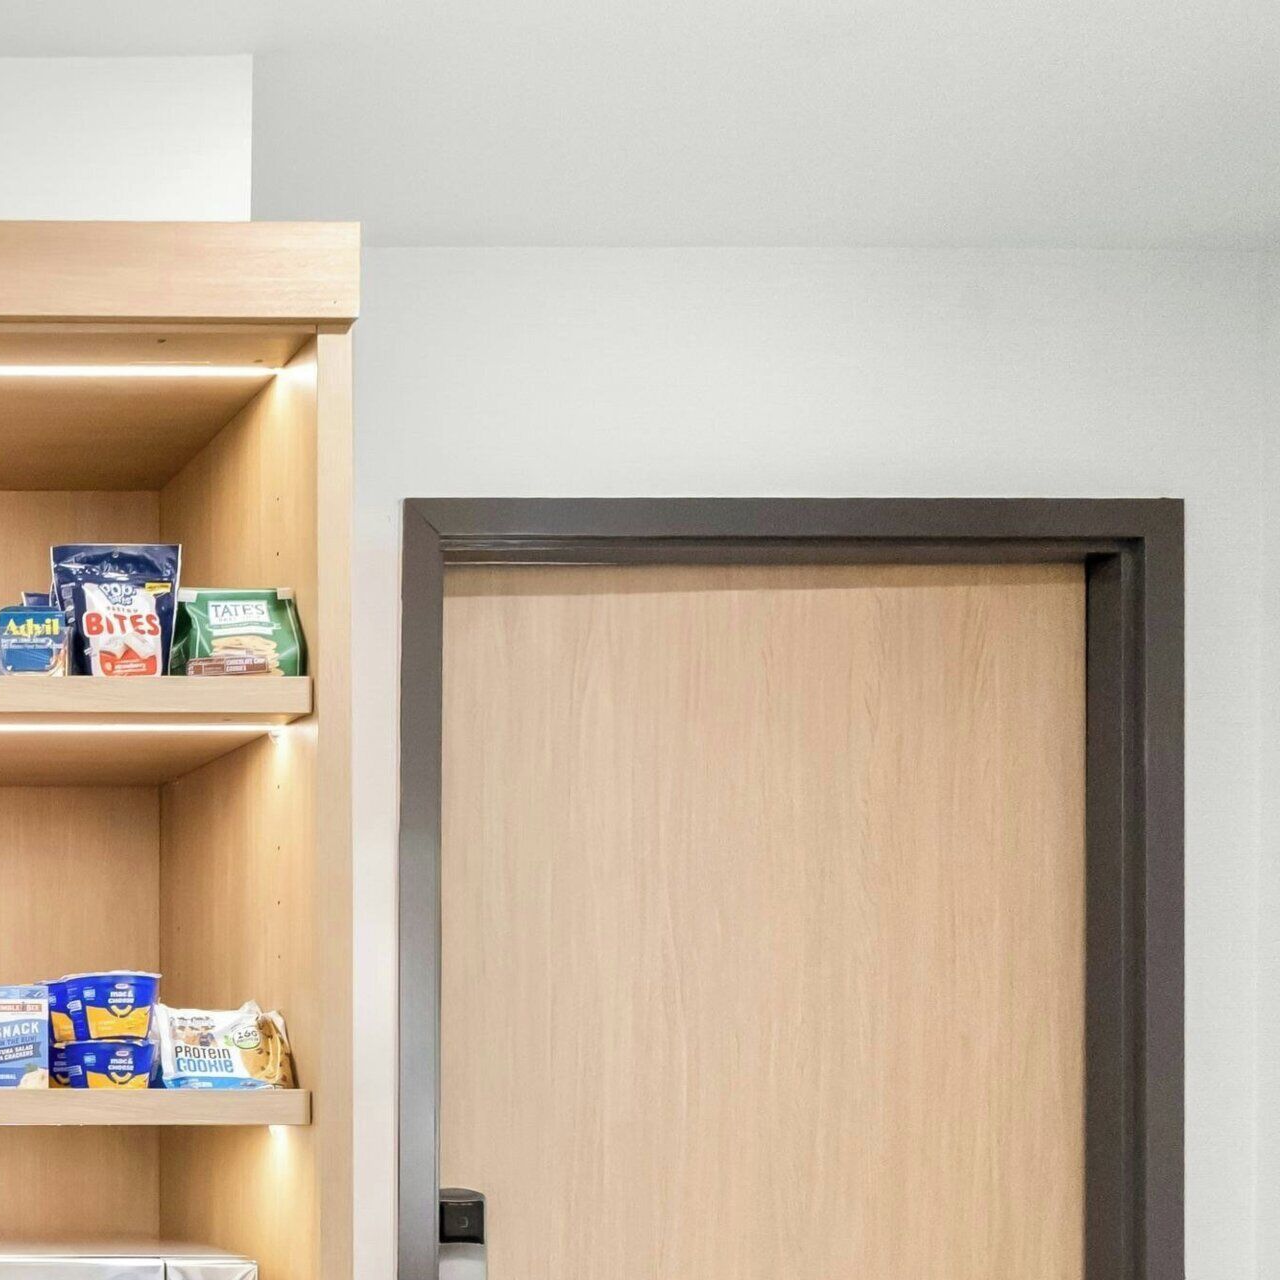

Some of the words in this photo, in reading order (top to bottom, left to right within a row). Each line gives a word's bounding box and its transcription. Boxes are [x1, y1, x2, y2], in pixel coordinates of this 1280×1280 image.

[211, 603, 265, 618] TATE'S
[3, 618, 60, 637] Advil
[85, 612, 160, 636] BITES
[4, 1051, 34, 1061] CRACKERS
[14, 1044, 34, 1054] SALAD
